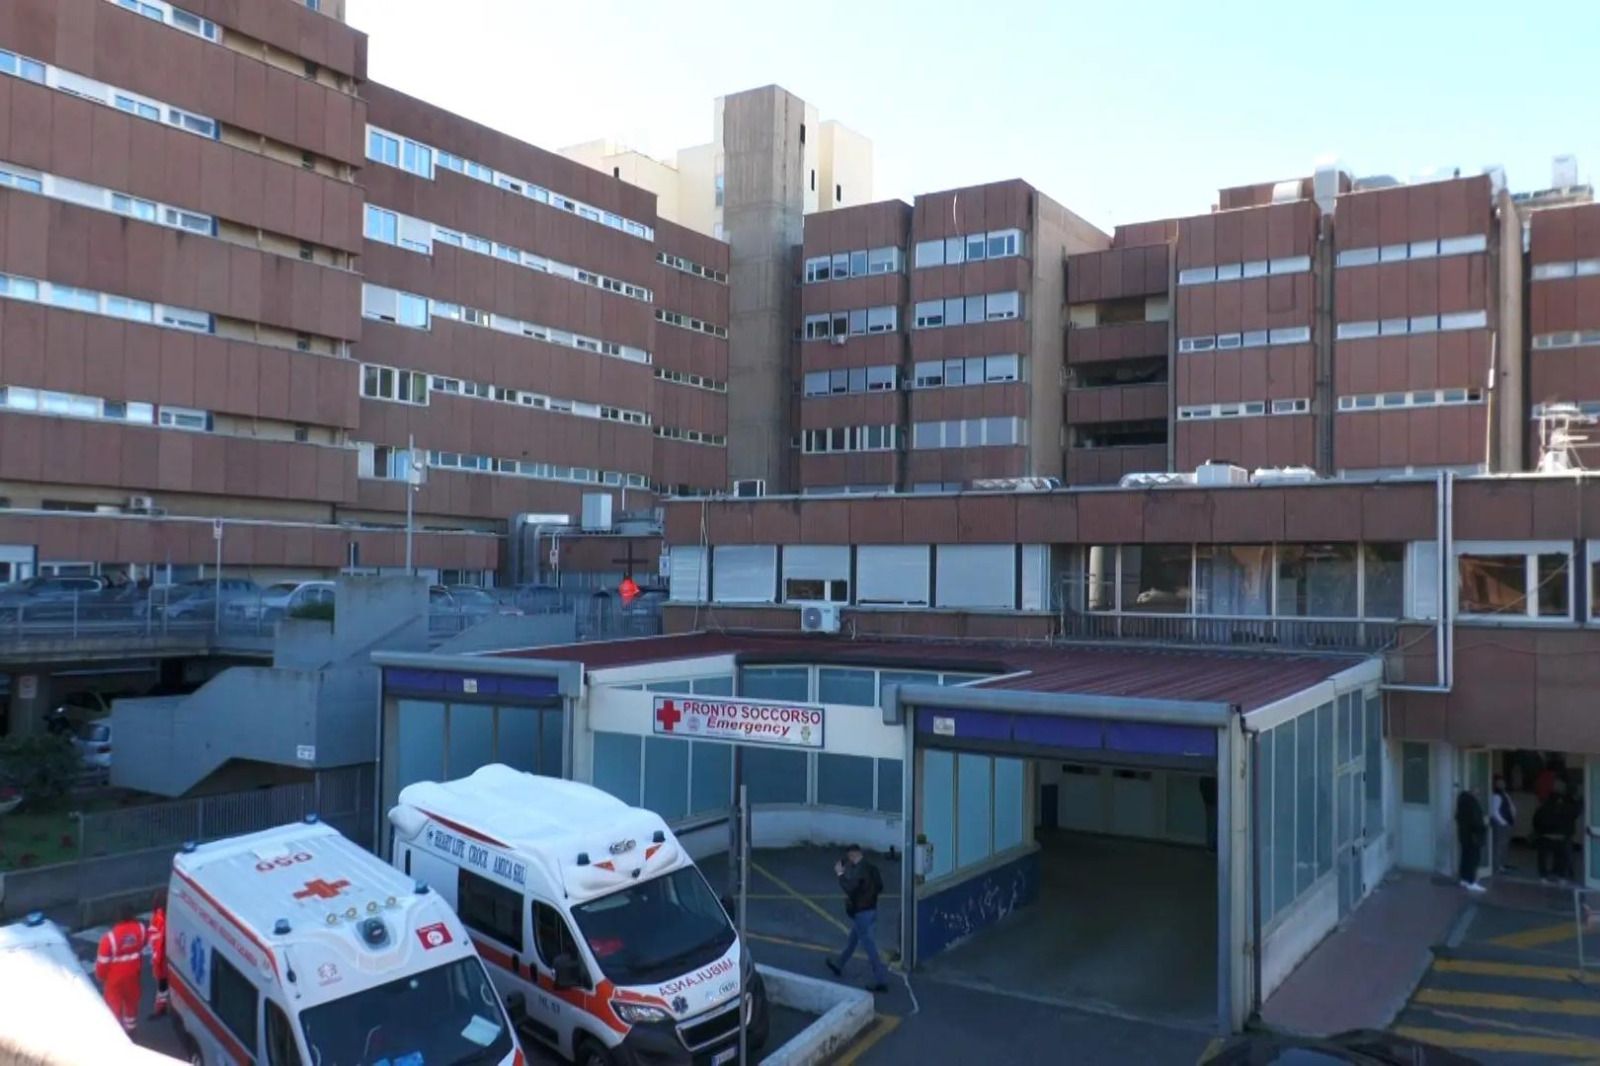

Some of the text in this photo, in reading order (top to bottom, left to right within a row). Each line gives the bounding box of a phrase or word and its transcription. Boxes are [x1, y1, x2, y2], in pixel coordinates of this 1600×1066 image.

[683, 702, 821, 725] PRONTO SOCCORSO
[707, 717, 791, 736] Emergency
[468, 844, 488, 868] CROCE
